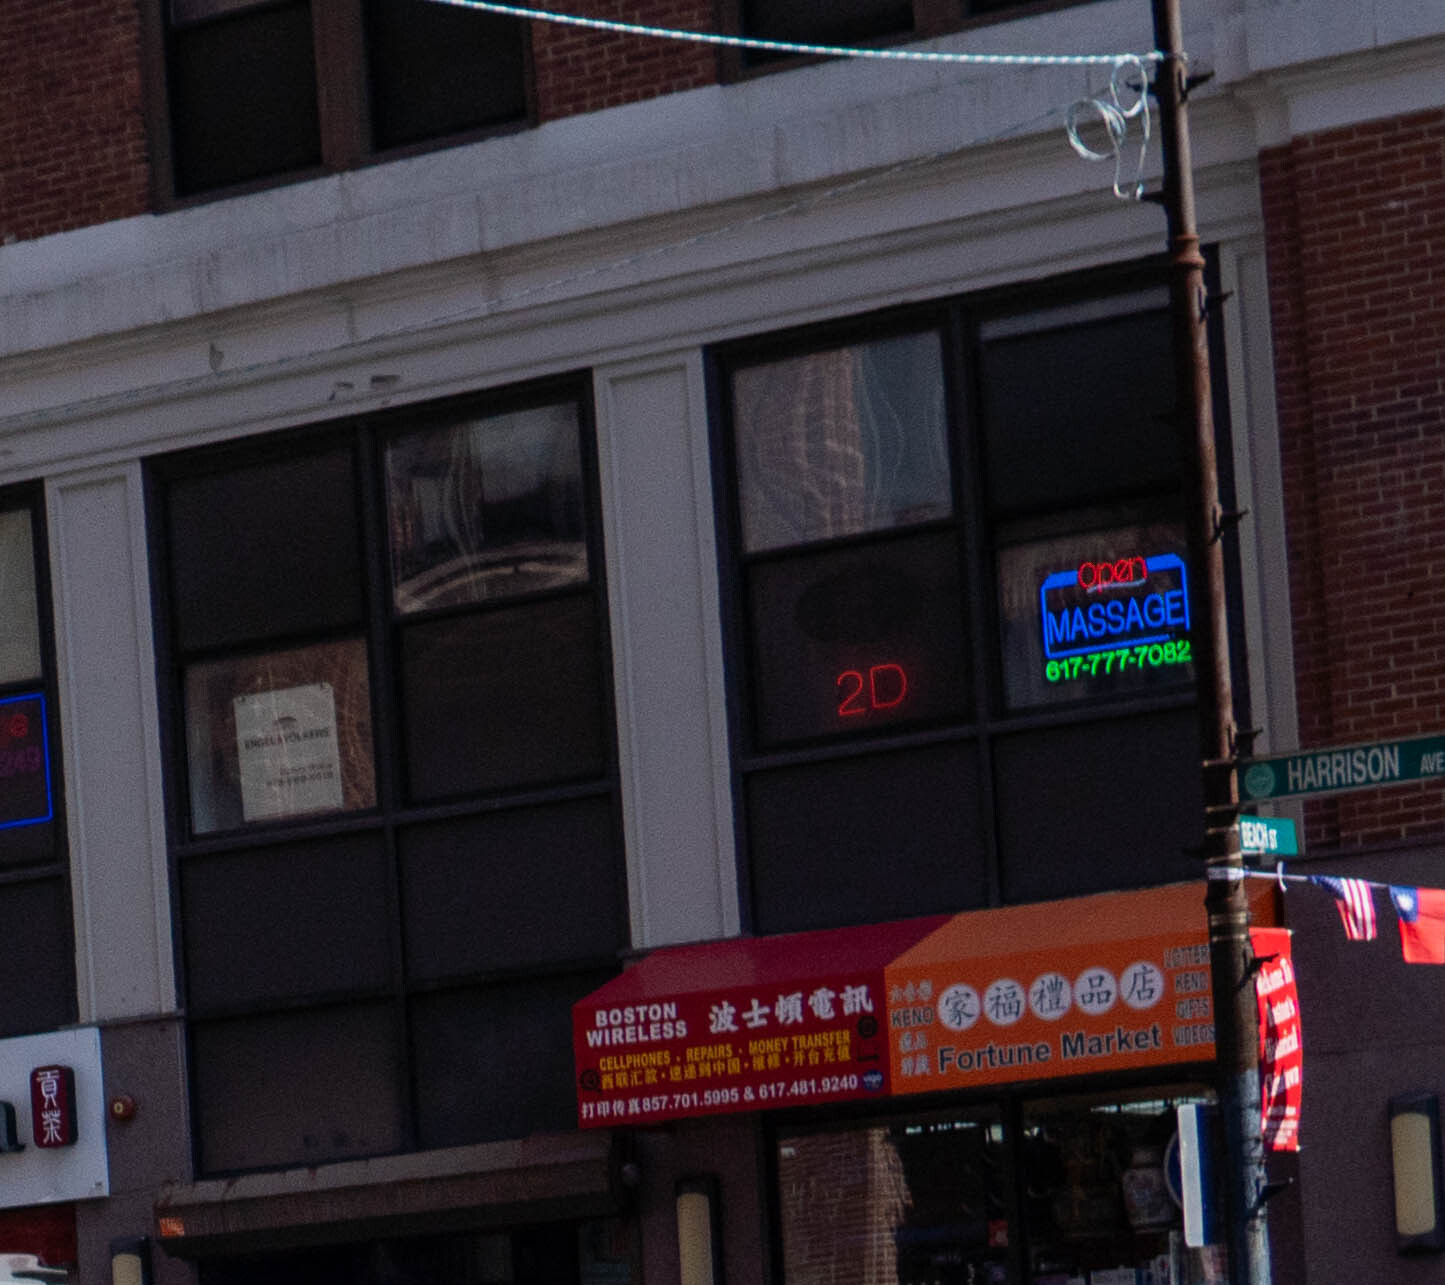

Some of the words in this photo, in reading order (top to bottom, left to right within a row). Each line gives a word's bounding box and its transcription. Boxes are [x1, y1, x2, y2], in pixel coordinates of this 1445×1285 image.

[1077, 553, 1149, 593] Open
[1047, 589, 1186, 646] MASSAGE
[837, 663, 909, 717] 2D
[1288, 745, 1400, 793] HARRISON
[1419, 751, 1445, 774] AVE
[1164, 943, 1211, 969] LOTTER
[595, 1001, 678, 1028] BOSTON
[708, 984, 875, 1034] 波士頓電訊
[943, 962, 1158, 1026] 家福禮品店
[585, 1019, 688, 1049] WIRELESS
[891, 1007, 934, 1029] KENO
[599, 1049, 672, 1072] CELLPHONES
[686, 1043, 733, 1062] REPAIRS
[748, 1035, 790, 1054] MONEY
[791, 1029, 852, 1053] TRANSFER
[937, 1040, 1052, 1075] Fortune
[1060, 1022, 1162, 1060] Market
[34, 1068, 64, 1146] 貢茶
[743, 1086, 755, 1101] &
[759, 1074, 859, 1099] 617.481.9240
